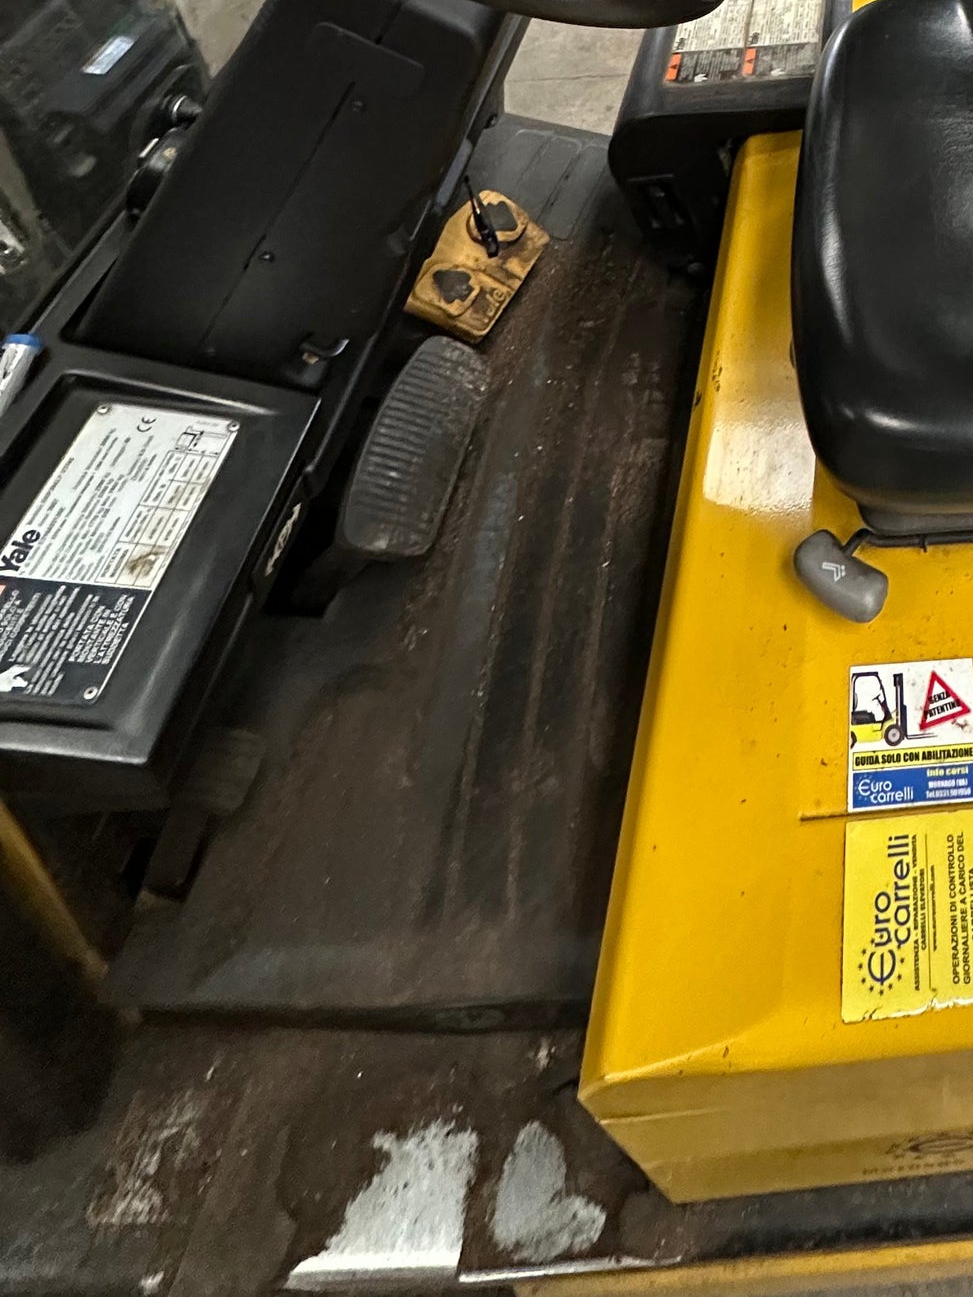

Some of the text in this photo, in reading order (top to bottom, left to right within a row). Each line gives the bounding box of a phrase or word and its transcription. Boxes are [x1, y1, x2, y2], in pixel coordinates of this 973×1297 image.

[0, 529, 41, 572] Yale
[927, 690, 952, 704] SENZA
[855, 747, 973, 766] GUIDA SOLO CON ABILITAZIONE
[870, 786, 914, 803] carrelli
[887, 834, 911, 946] carrelli
[958, 855, 966, 895] CARICO
[946, 834, 960, 984] OPERAZIONI DI CONTROLLO
[959, 897, 967, 905] A
[961, 908, 971, 985] GIORNALIERE
